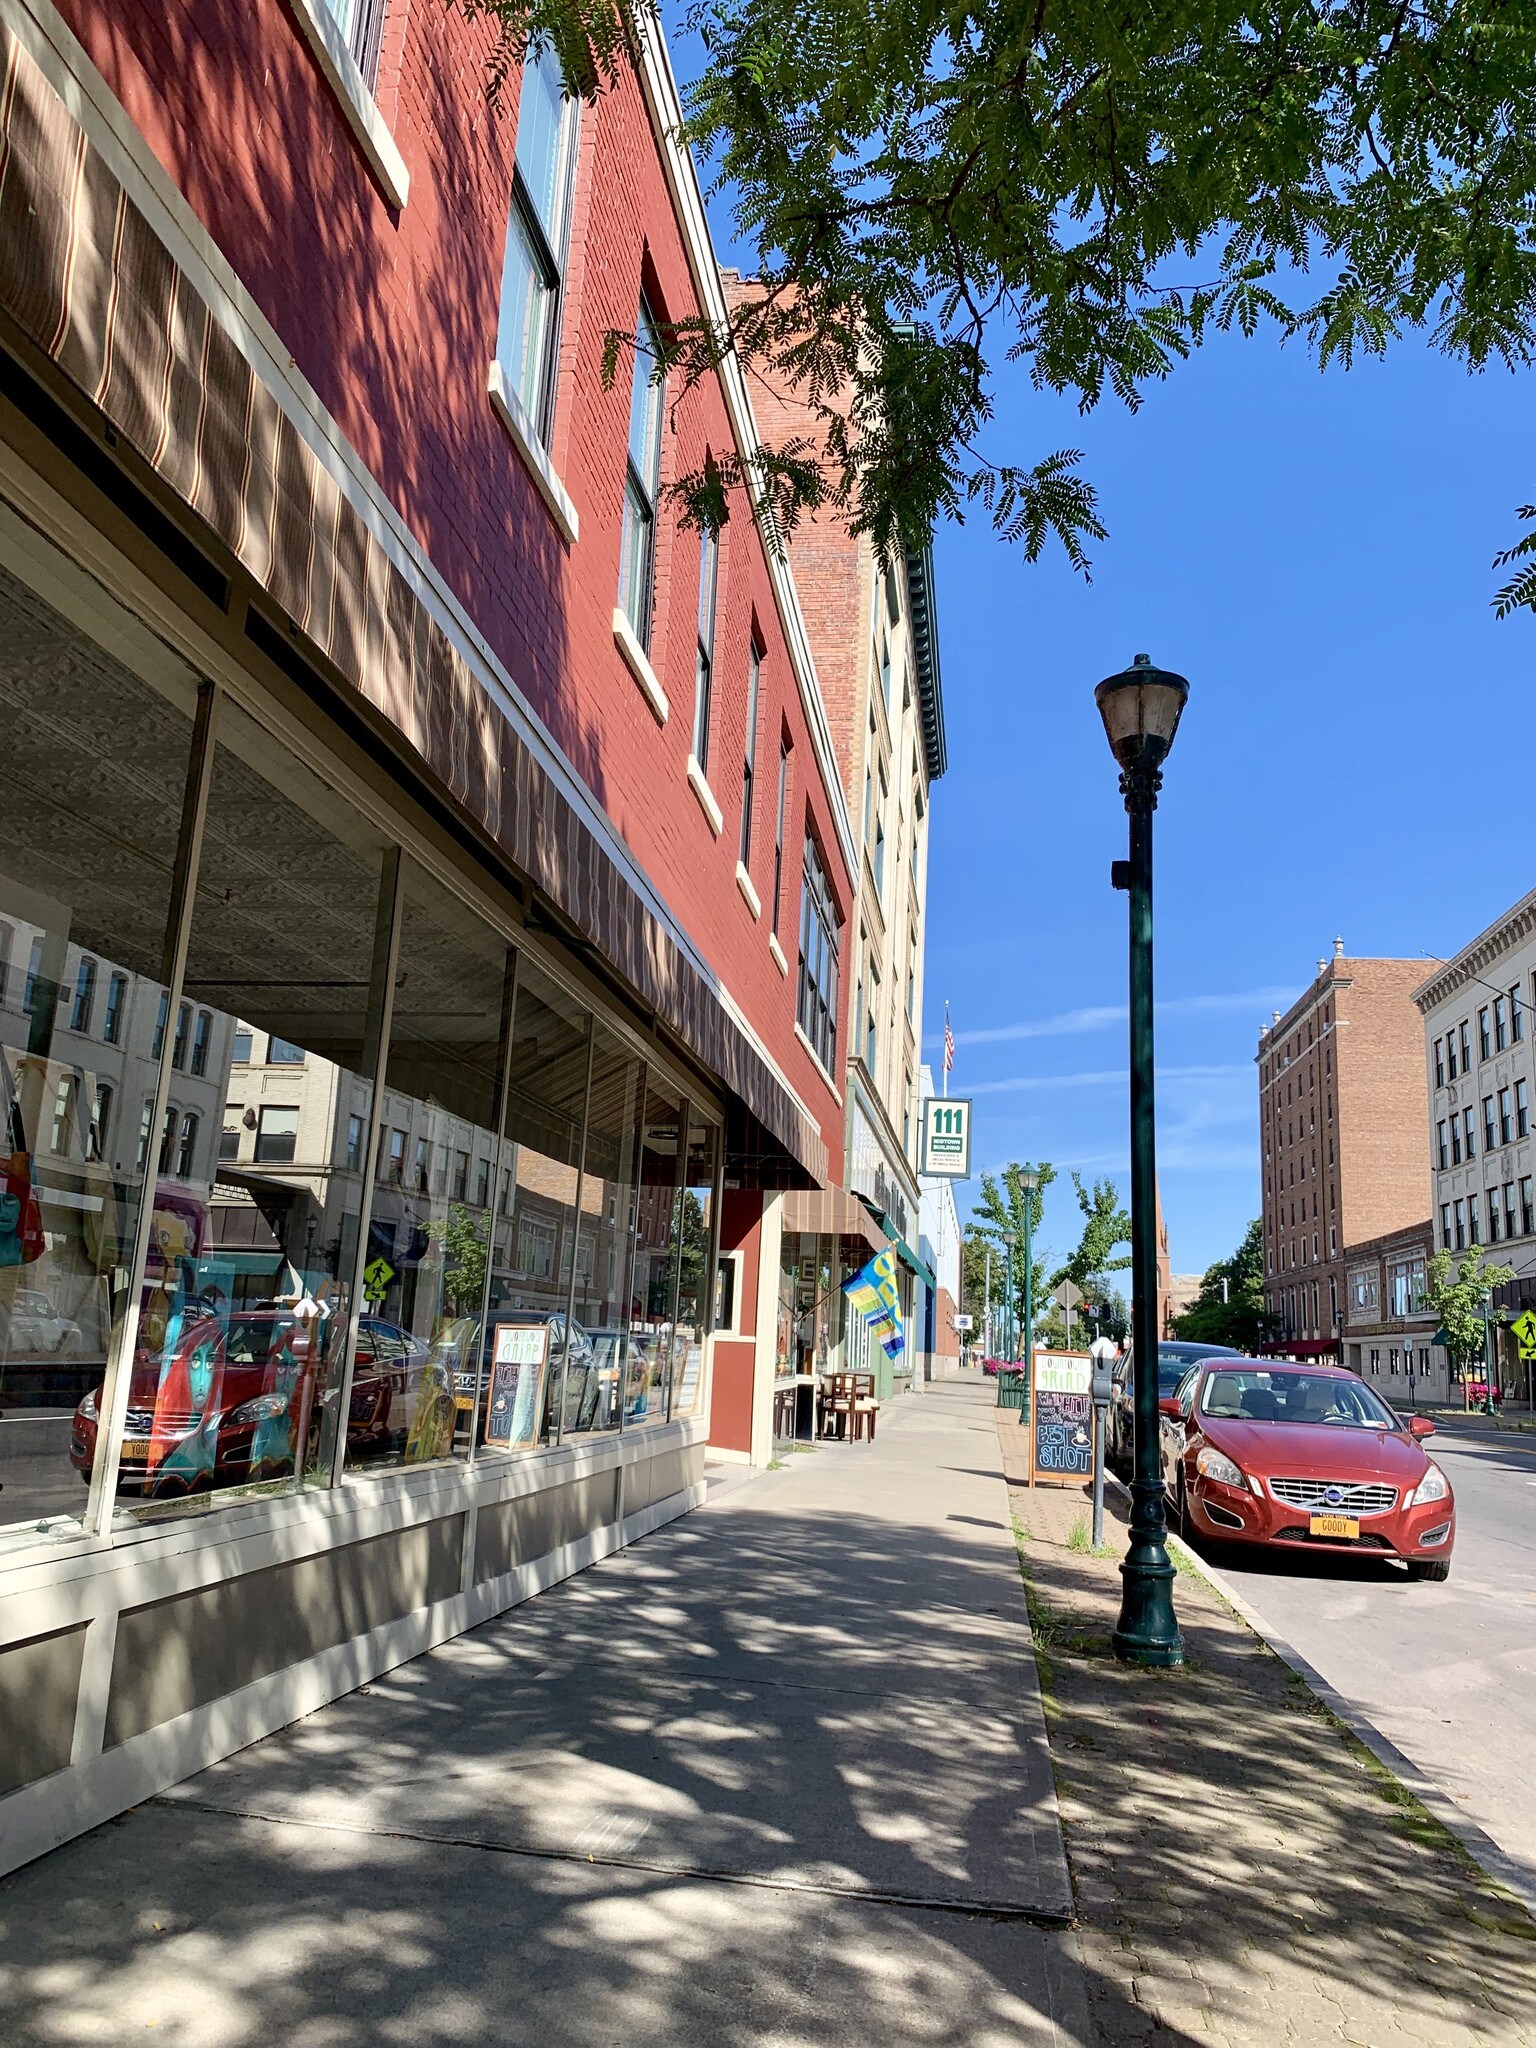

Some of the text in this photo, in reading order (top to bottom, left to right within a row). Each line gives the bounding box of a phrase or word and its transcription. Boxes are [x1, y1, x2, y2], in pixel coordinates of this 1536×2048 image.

[933, 1108, 962, 1134] 111
[1037, 1424, 1073, 1448] BEST
[1039, 1444, 1093, 1472] SHOT
[1322, 1519, 1348, 1533] GOODY
